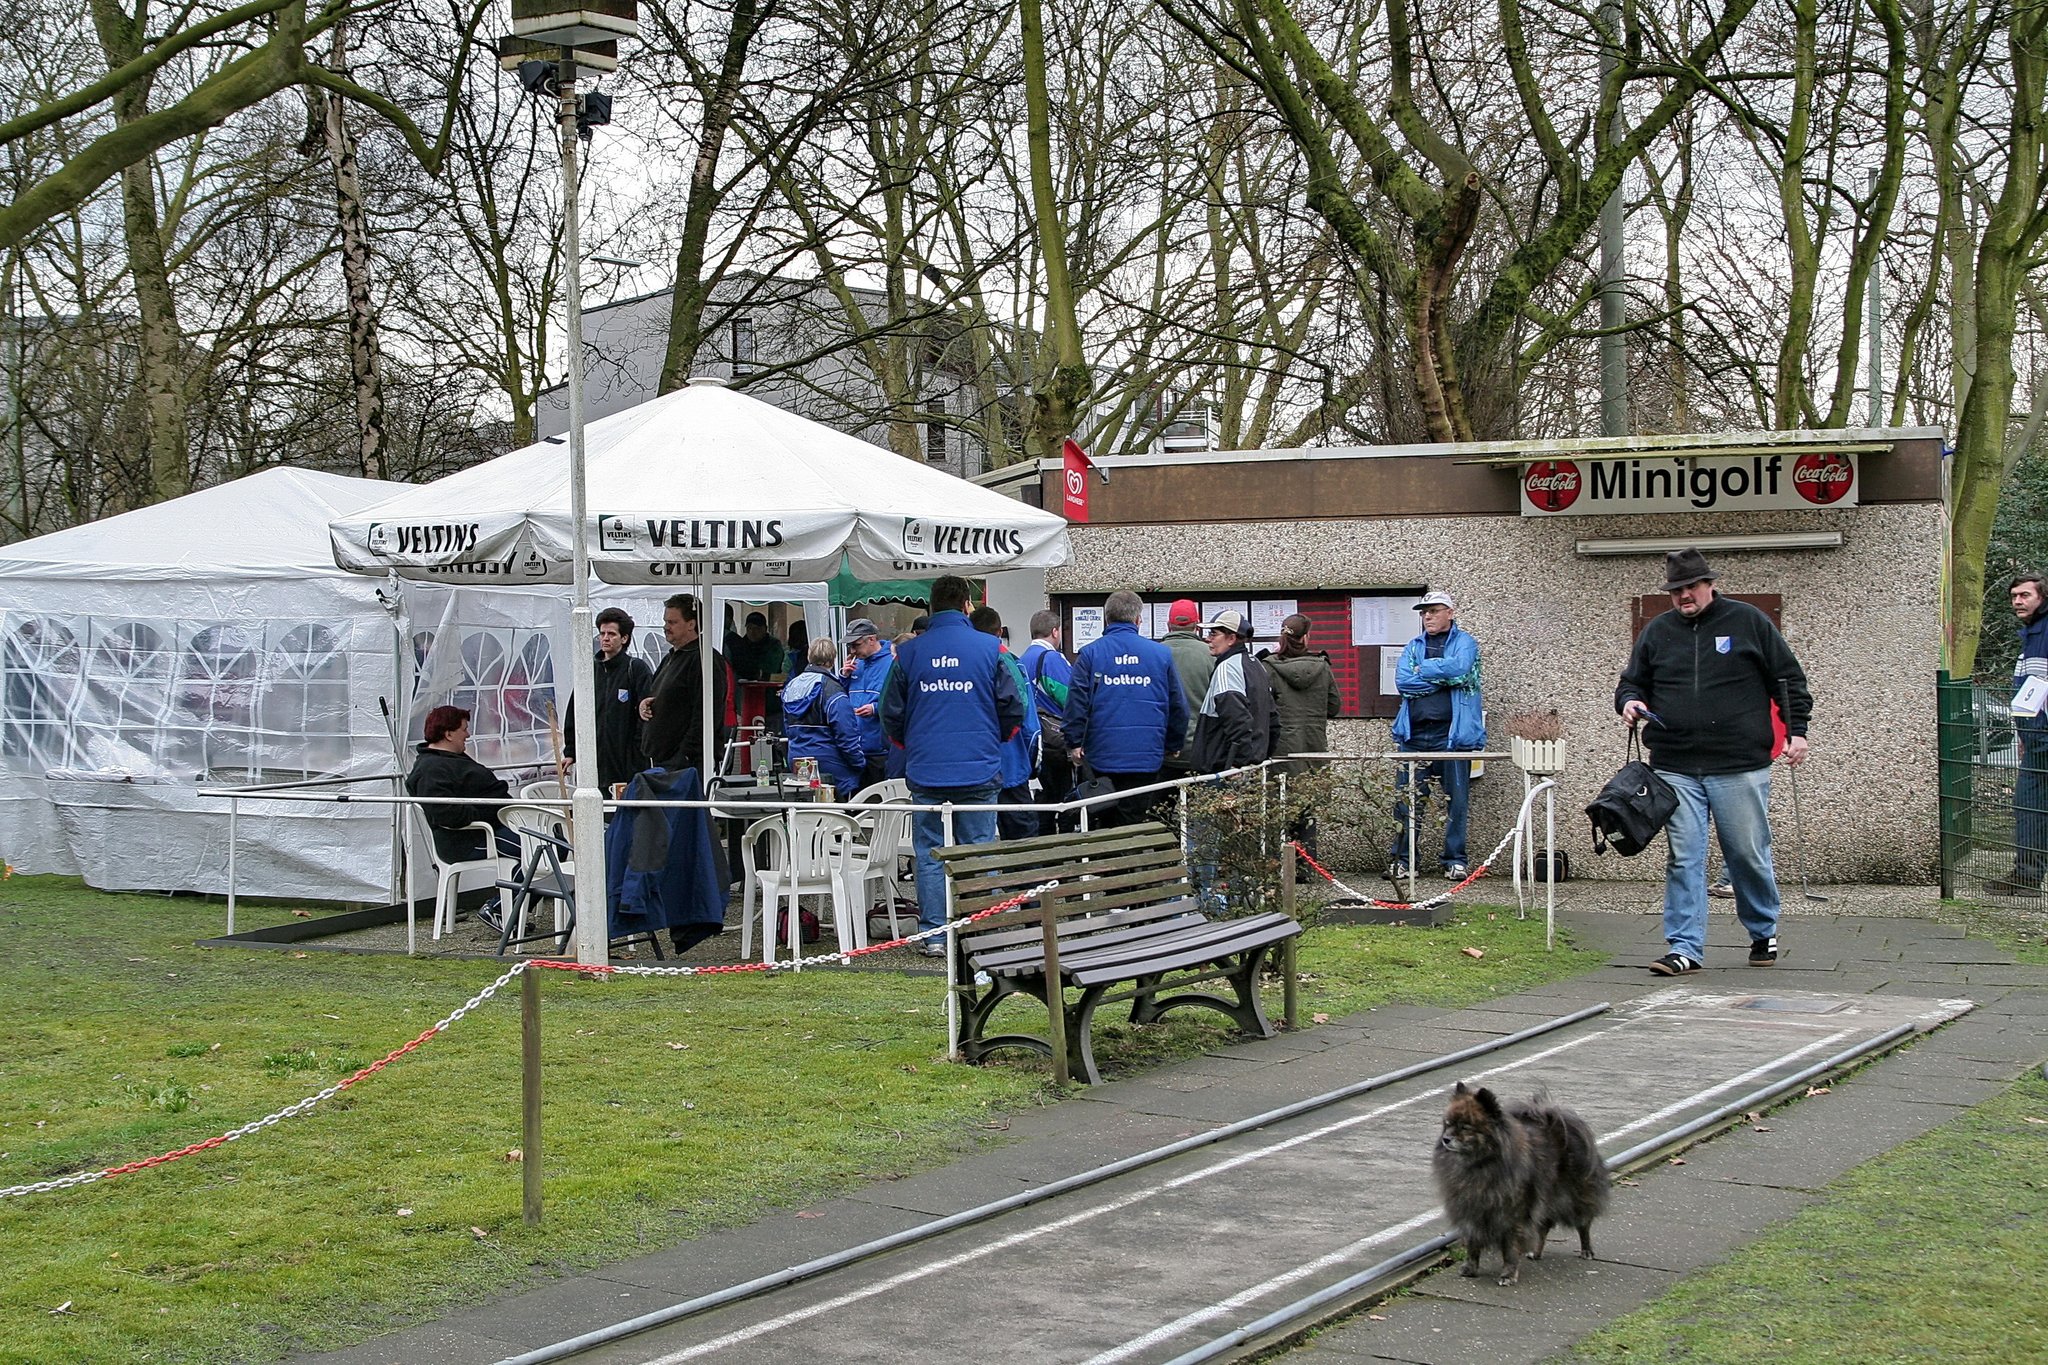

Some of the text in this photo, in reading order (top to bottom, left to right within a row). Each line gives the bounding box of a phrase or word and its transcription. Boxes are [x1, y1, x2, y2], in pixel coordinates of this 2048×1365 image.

[1590, 456, 1782, 508] Minigolf
[397, 523, 479, 553] VELTINS
[646, 519, 783, 549] VELTINS
[934, 525, 1024, 555] VELTINS
[931, 655, 959, 668] ufm
[1114, 653, 1140, 665] ufm
[919, 679, 974, 694] bottrop
[1103, 673, 1152, 687] bottrop
